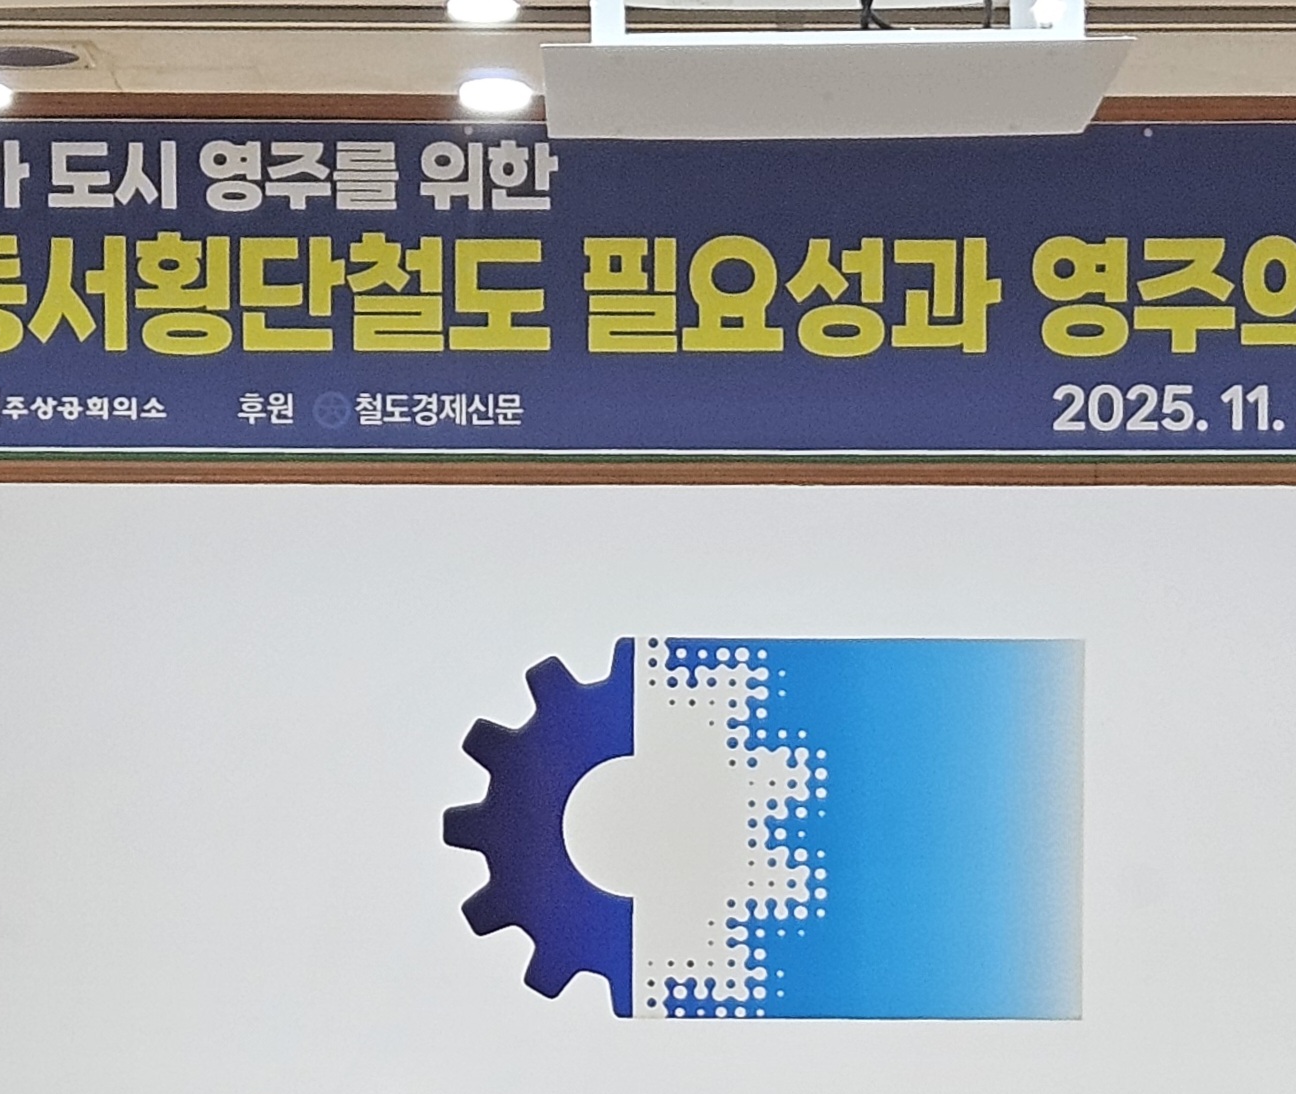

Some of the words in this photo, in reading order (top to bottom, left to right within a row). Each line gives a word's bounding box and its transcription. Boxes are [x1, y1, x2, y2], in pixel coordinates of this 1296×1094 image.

[48, 141, 179, 211] 도시
[200, 141, 401, 213] 영주를
[420, 140, 559, 212] 위한
[584, 234, 1003, 358] 필요성과
[237, 393, 295, 426] 후원
[355, 393, 526, 427] 철도경제신문
[1053, 384, 1210, 433] 2025.
[1221, 385, 1286, 433] 11.
